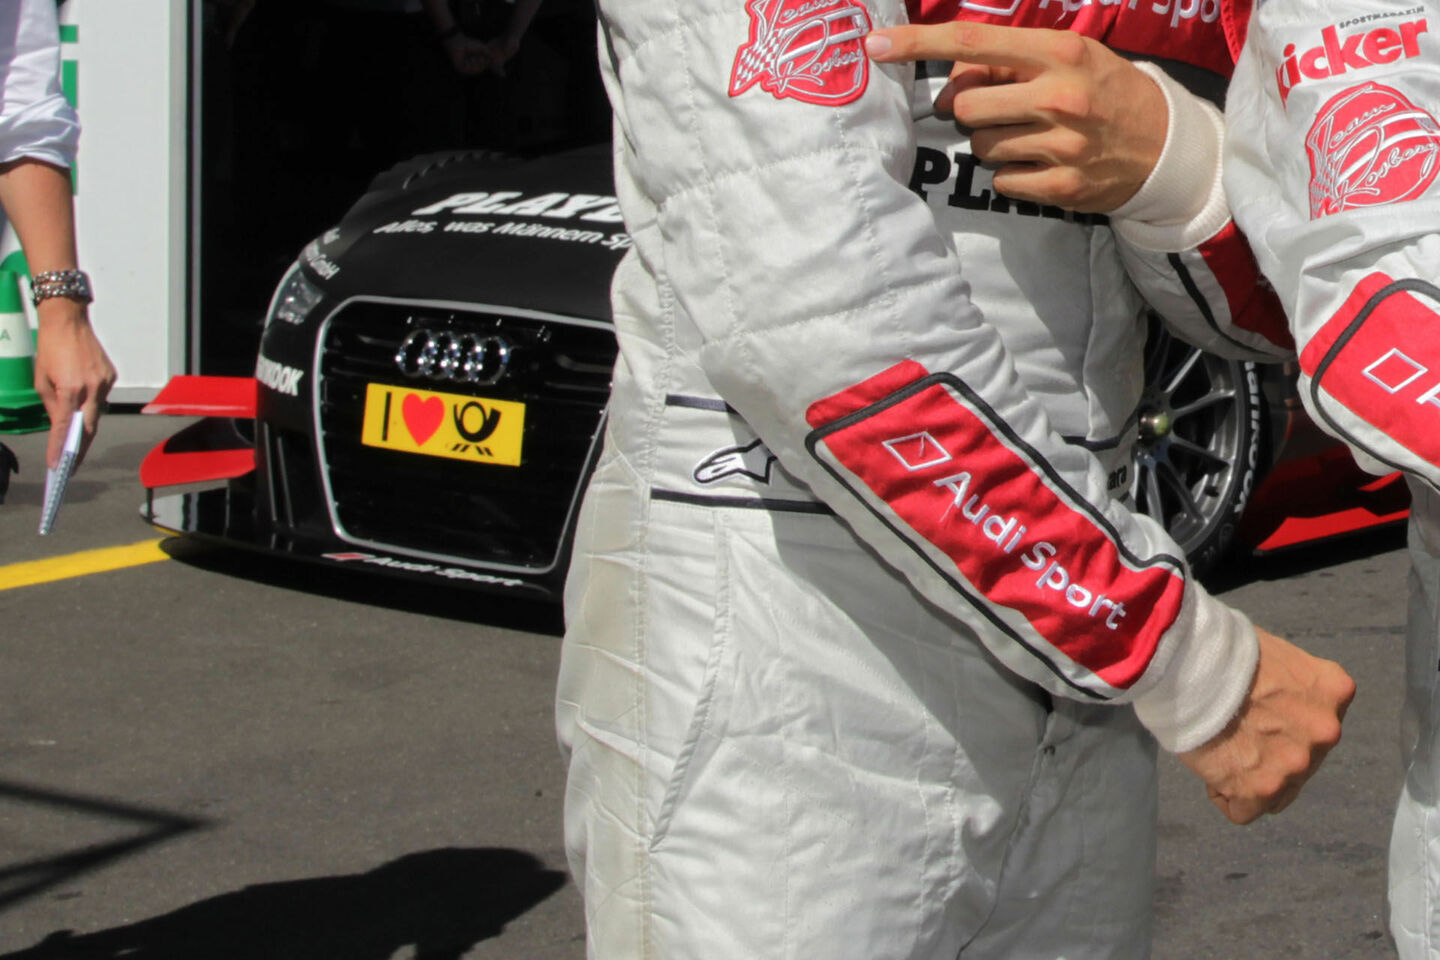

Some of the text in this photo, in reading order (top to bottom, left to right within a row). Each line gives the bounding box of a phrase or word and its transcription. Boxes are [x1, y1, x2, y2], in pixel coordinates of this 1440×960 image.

[1329, 124, 1440, 211] Rosberg
[444, 220, 496, 234] was
[601, 233, 636, 252] Sp
[381, 391, 392, 442] I
[364, 556, 524, 586] Audi Sport
[933, 470, 1127, 632] Audi Sport
